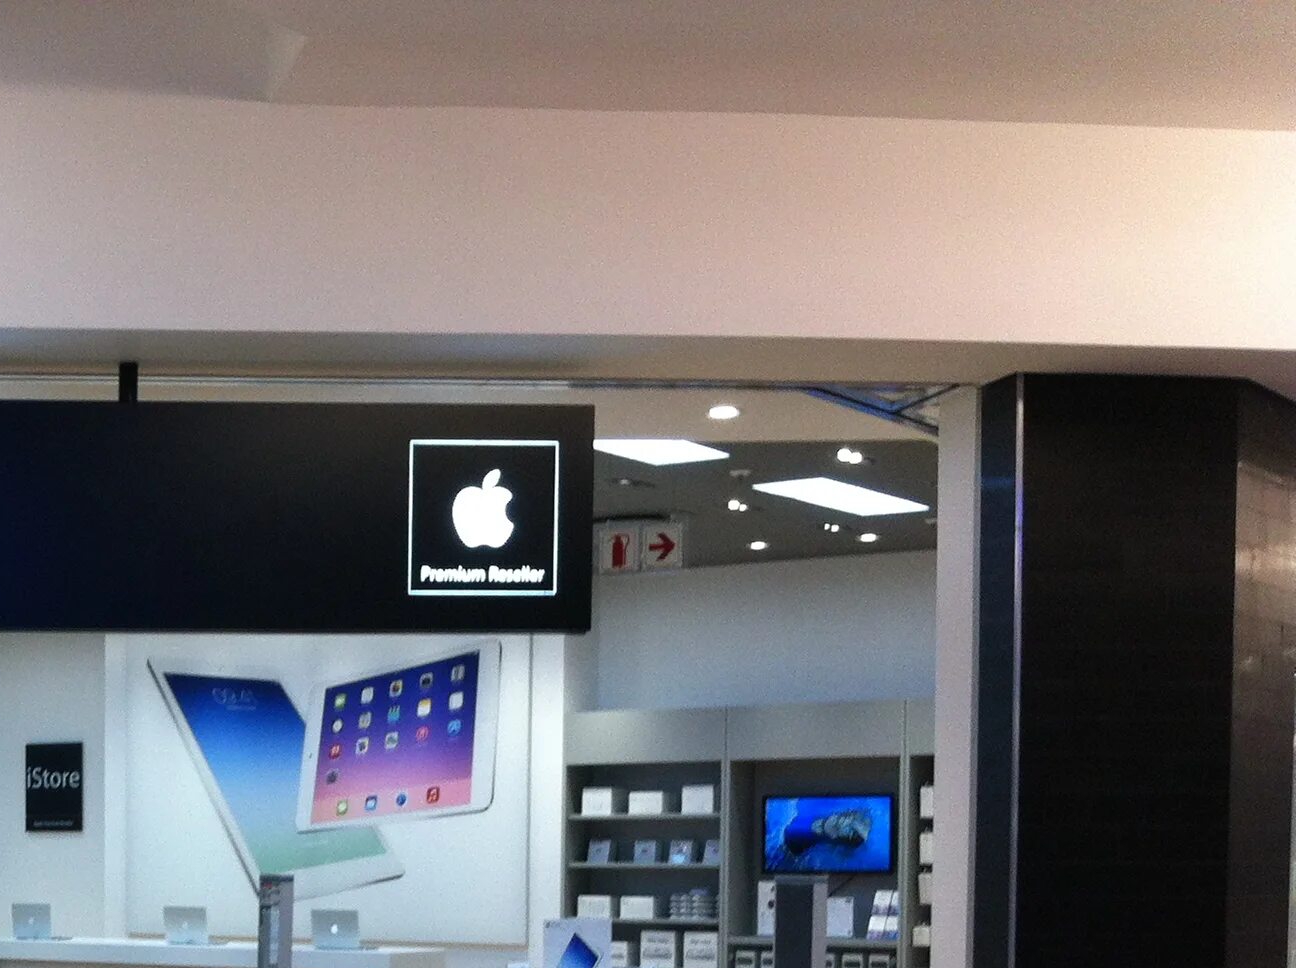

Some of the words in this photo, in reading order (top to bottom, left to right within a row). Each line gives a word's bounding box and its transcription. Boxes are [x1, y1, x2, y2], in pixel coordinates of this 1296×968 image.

[420, 564, 486, 583] Premium
[488, 564, 545, 583] Reseller
[26, 766, 81, 790] iStore
